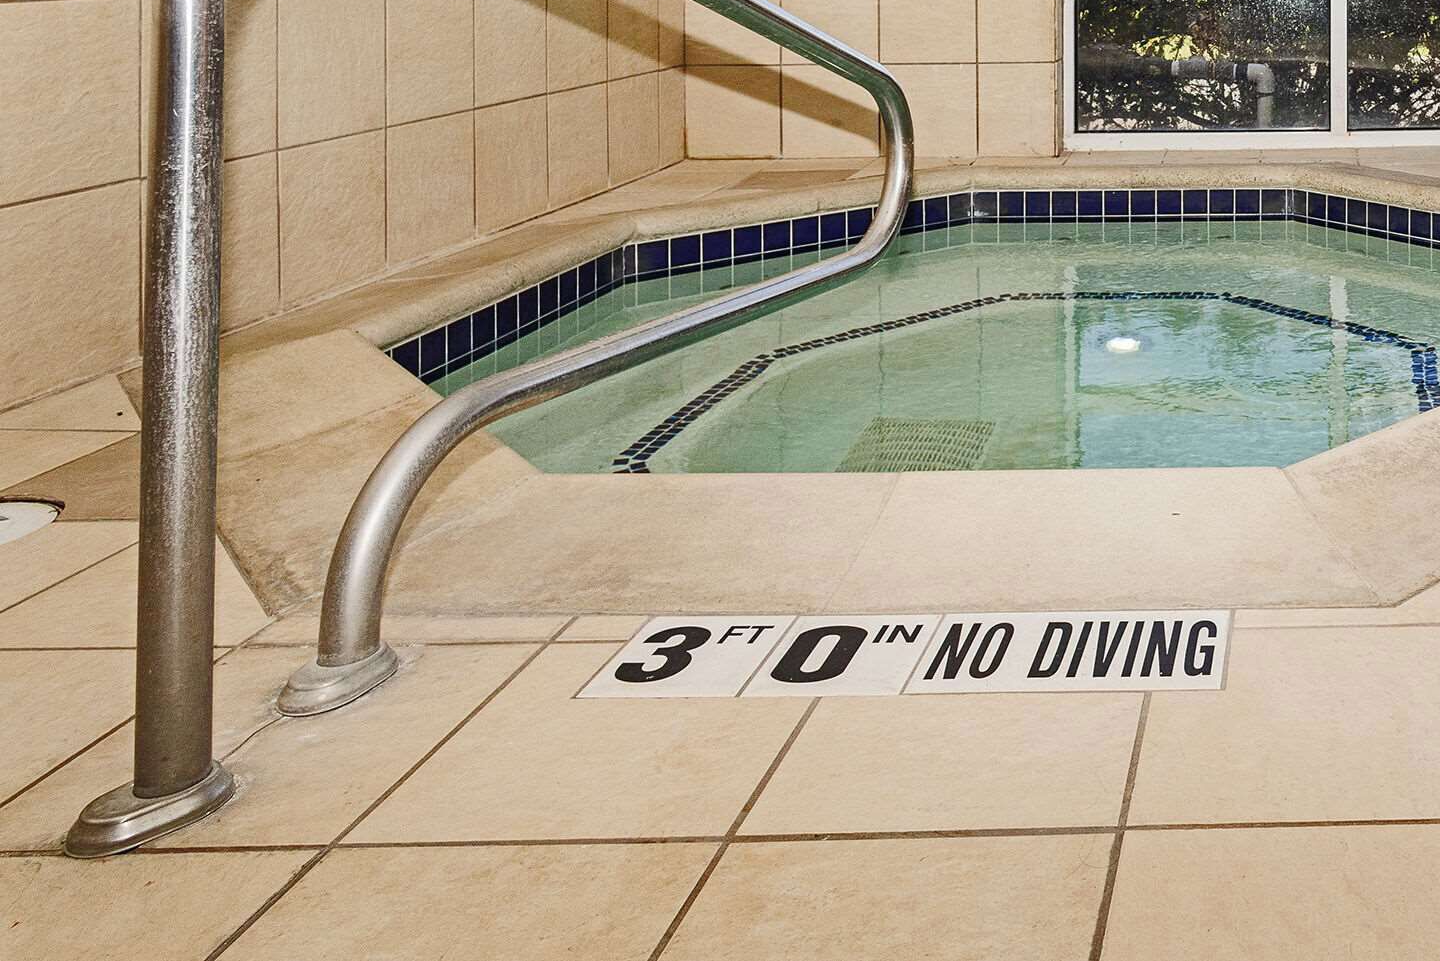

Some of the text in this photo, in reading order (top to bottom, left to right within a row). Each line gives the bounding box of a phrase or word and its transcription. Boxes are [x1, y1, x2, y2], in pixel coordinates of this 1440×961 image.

[614, 620, 1217, 683] 3 FT 0 IN NO DIVING
